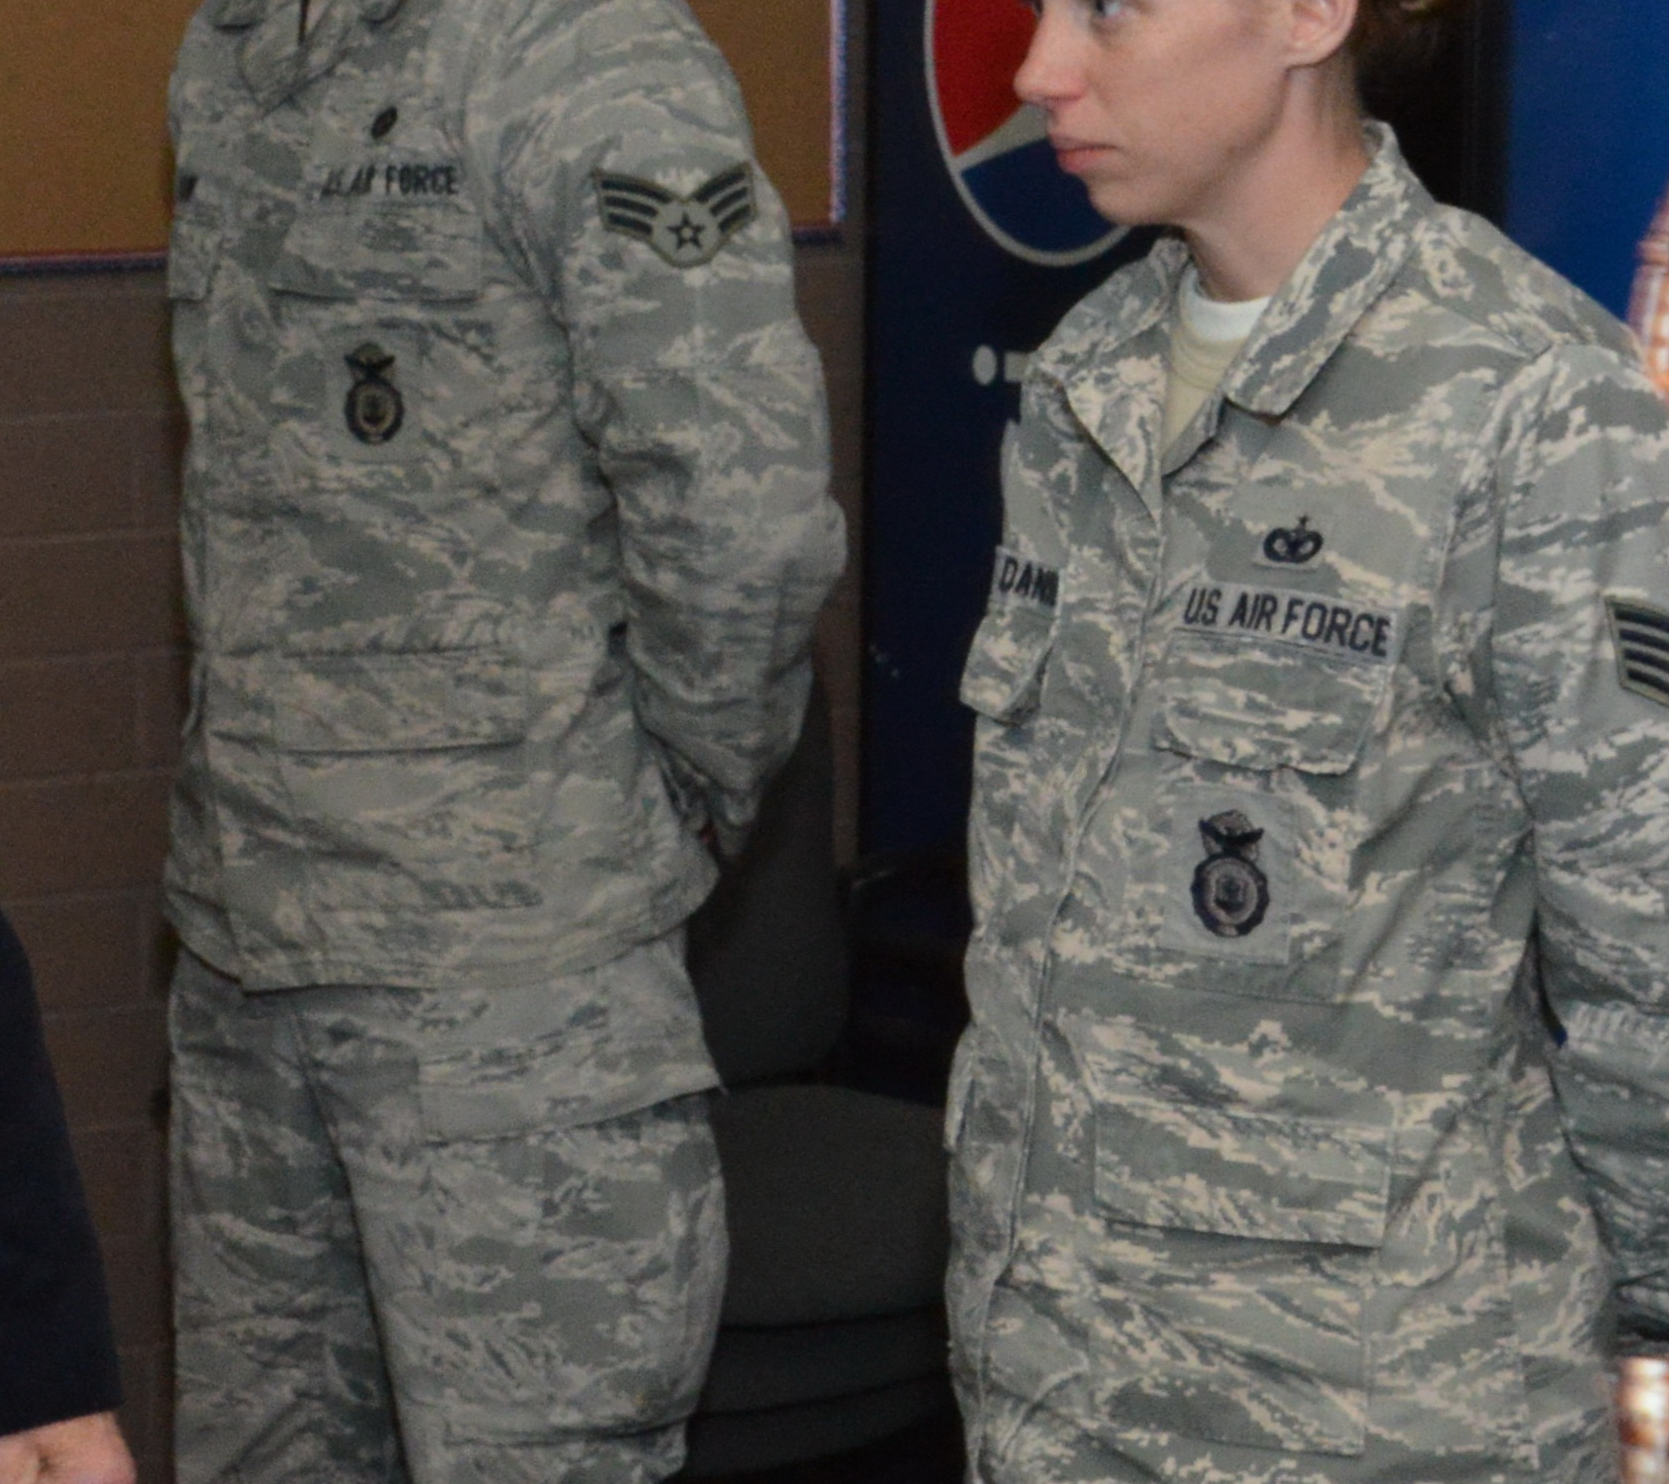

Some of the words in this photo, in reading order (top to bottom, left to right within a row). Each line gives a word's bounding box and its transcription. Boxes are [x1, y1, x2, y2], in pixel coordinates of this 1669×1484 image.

[385, 164, 460, 196] FORCE
[1229, 592, 1281, 634] AIR
[1281, 597, 1392, 657] FORCE
